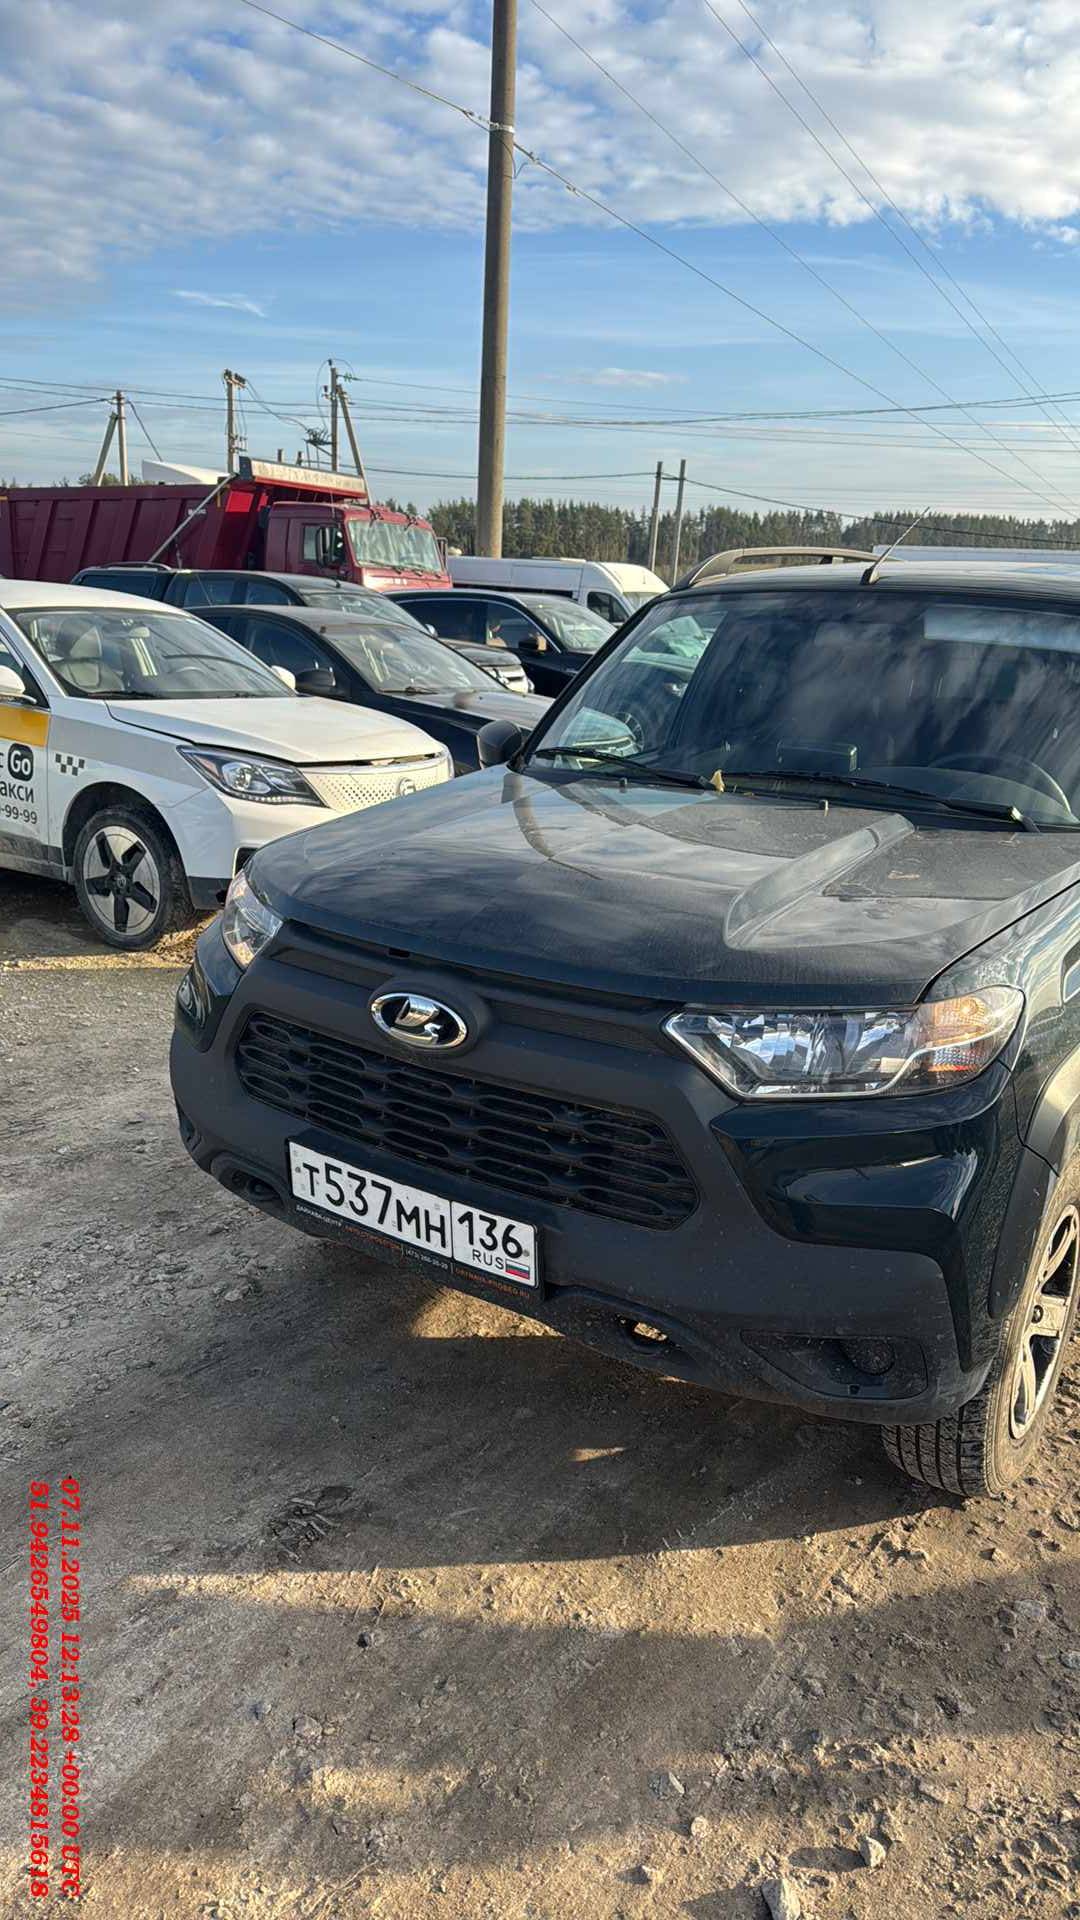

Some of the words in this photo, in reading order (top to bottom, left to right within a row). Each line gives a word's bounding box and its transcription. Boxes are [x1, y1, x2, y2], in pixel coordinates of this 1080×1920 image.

[10, 750, 31, 775] Go
[457, 1211, 523, 1260] 136
[472, 1249, 504, 1270] RUS
